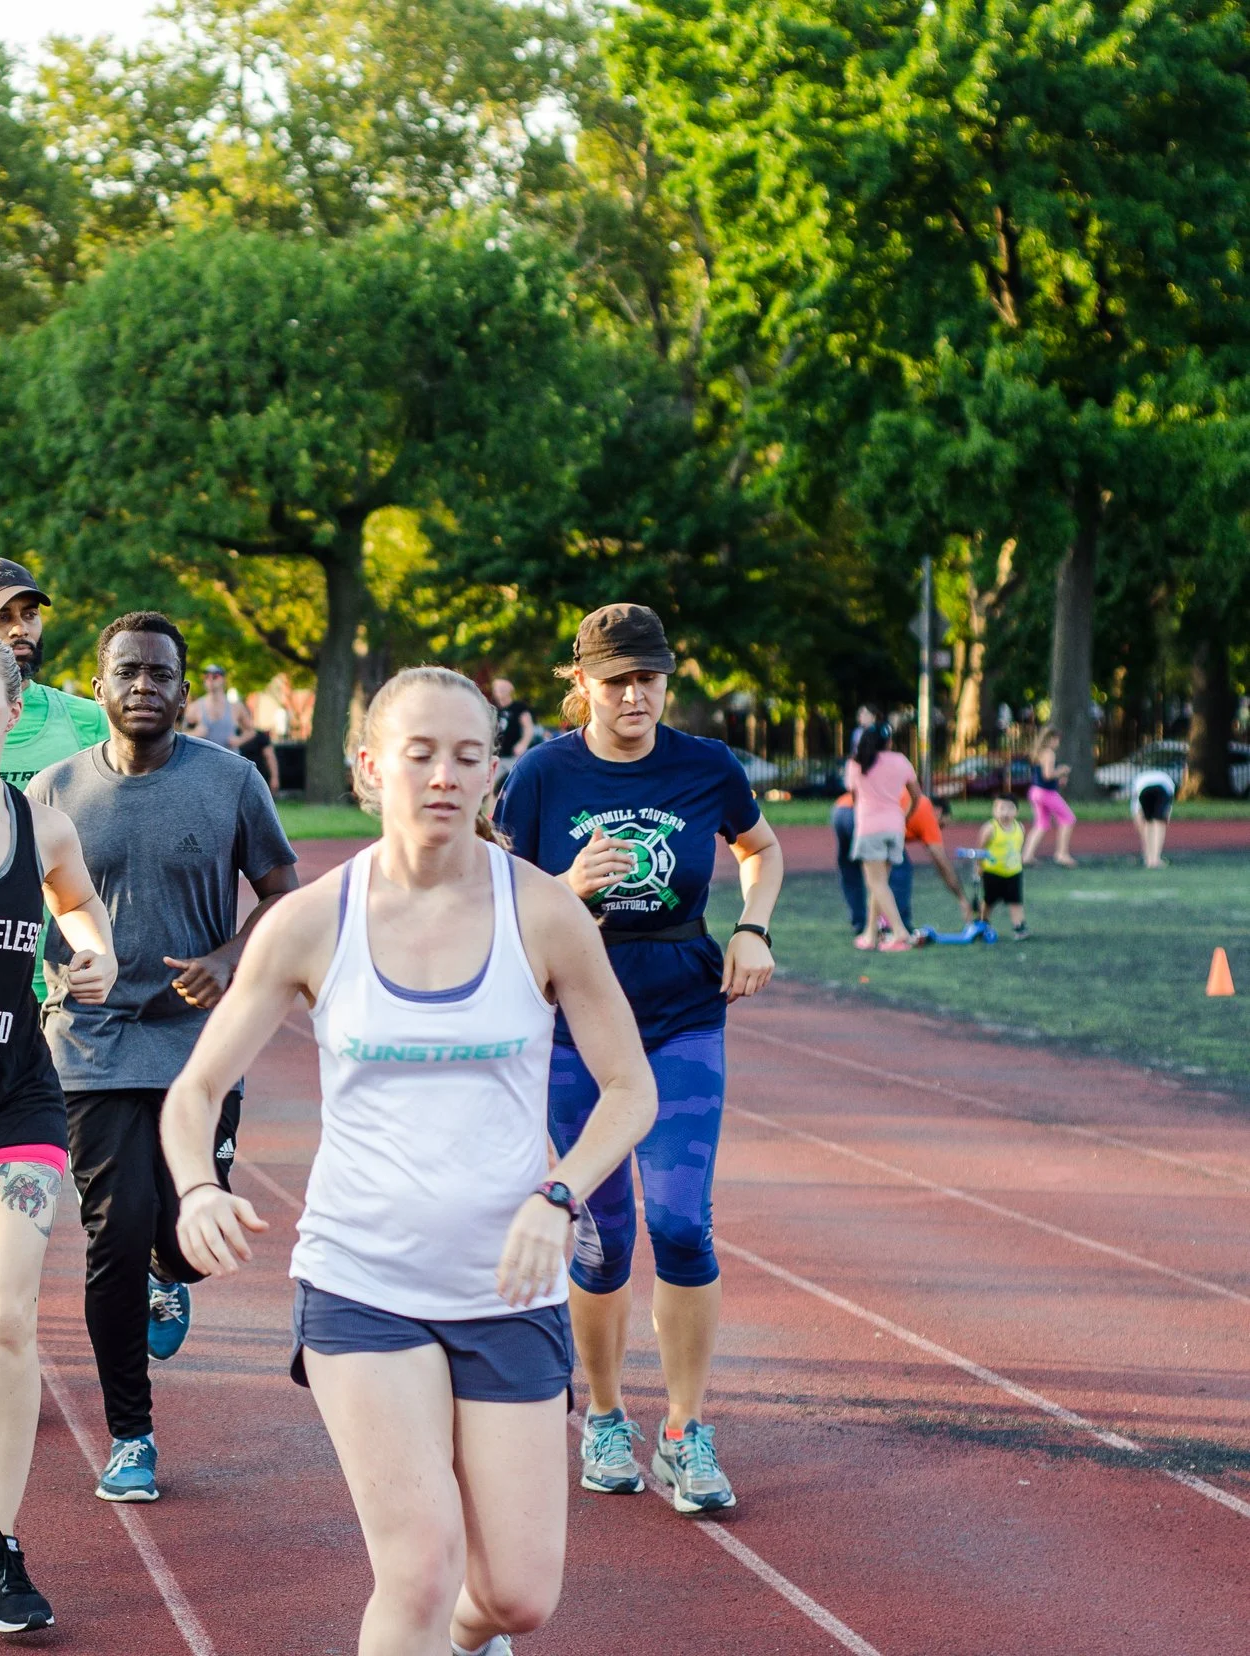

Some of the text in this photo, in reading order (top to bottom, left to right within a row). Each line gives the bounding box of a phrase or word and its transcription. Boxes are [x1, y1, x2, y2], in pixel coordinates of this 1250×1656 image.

[569, 808, 686, 840] WINDMILL TAVERN
[650, 900, 663, 911] CT
[338, 1034, 529, 1064] RUNSTREET
